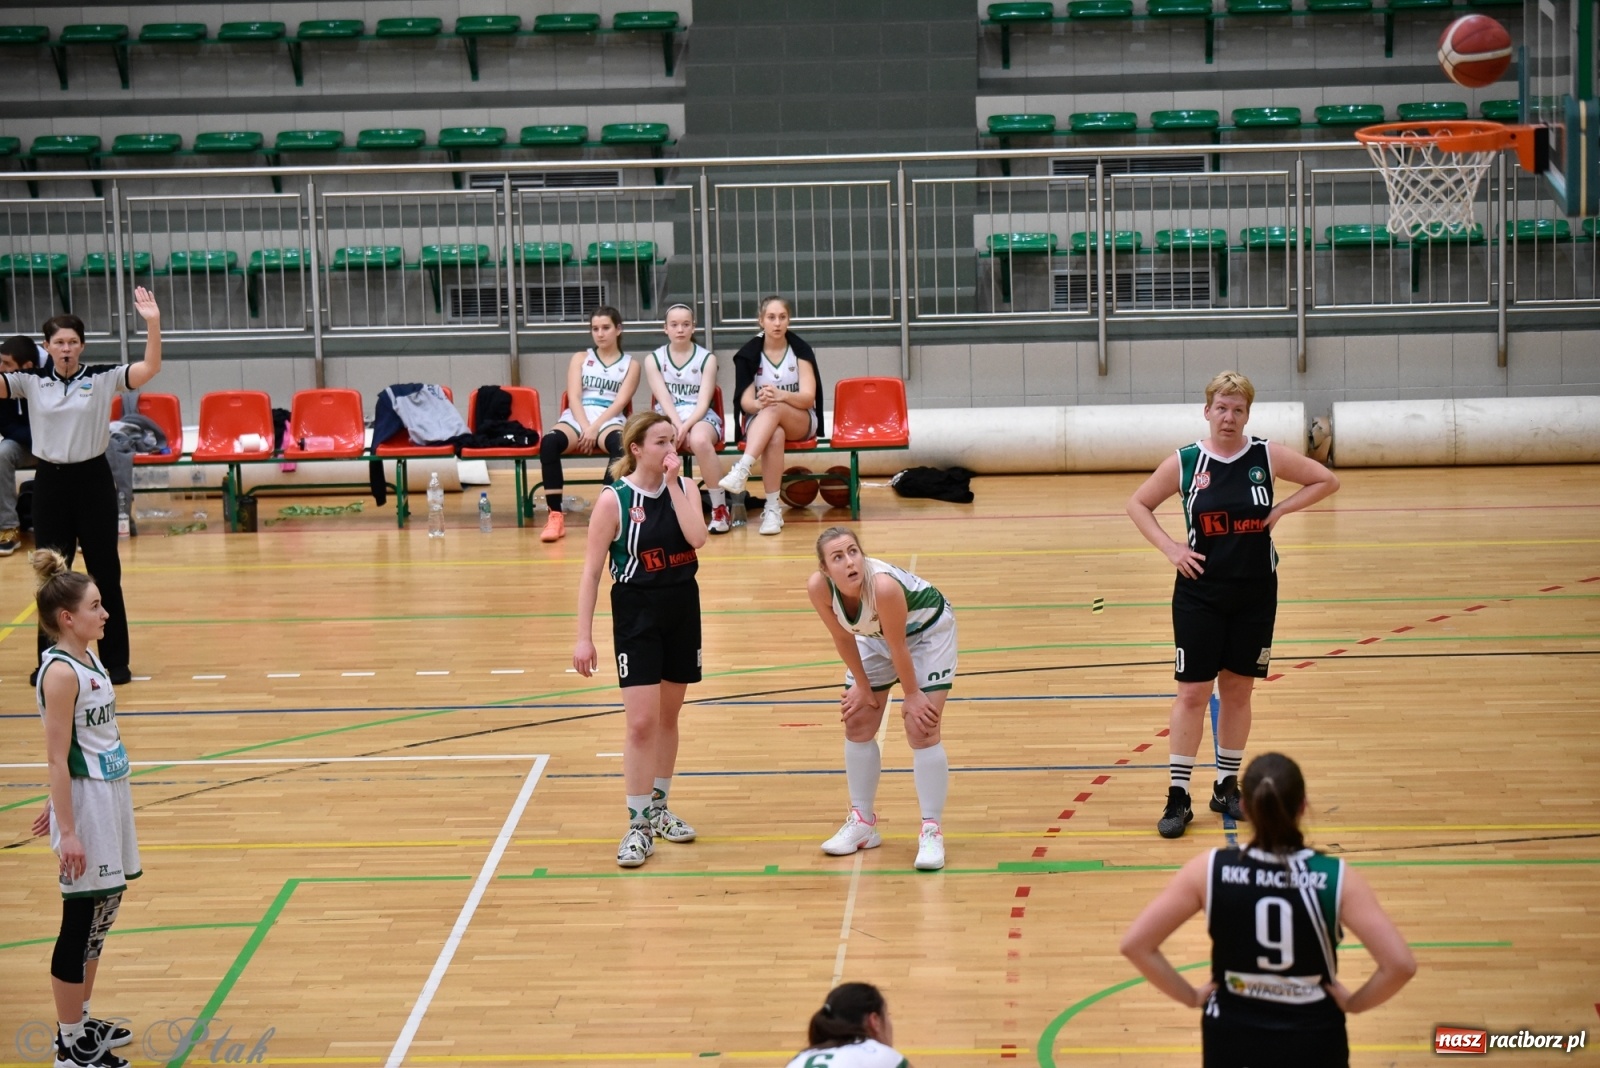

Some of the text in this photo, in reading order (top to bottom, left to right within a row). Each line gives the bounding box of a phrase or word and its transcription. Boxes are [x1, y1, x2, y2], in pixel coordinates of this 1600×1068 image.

[1251, 485, 1269, 506] 10
[1202, 514, 1225, 533] K
[643, 551, 664, 570] K
[618, 652, 629, 678] 8
[1221, 865, 1250, 885] RKK
[1255, 895, 1294, 972] 9
